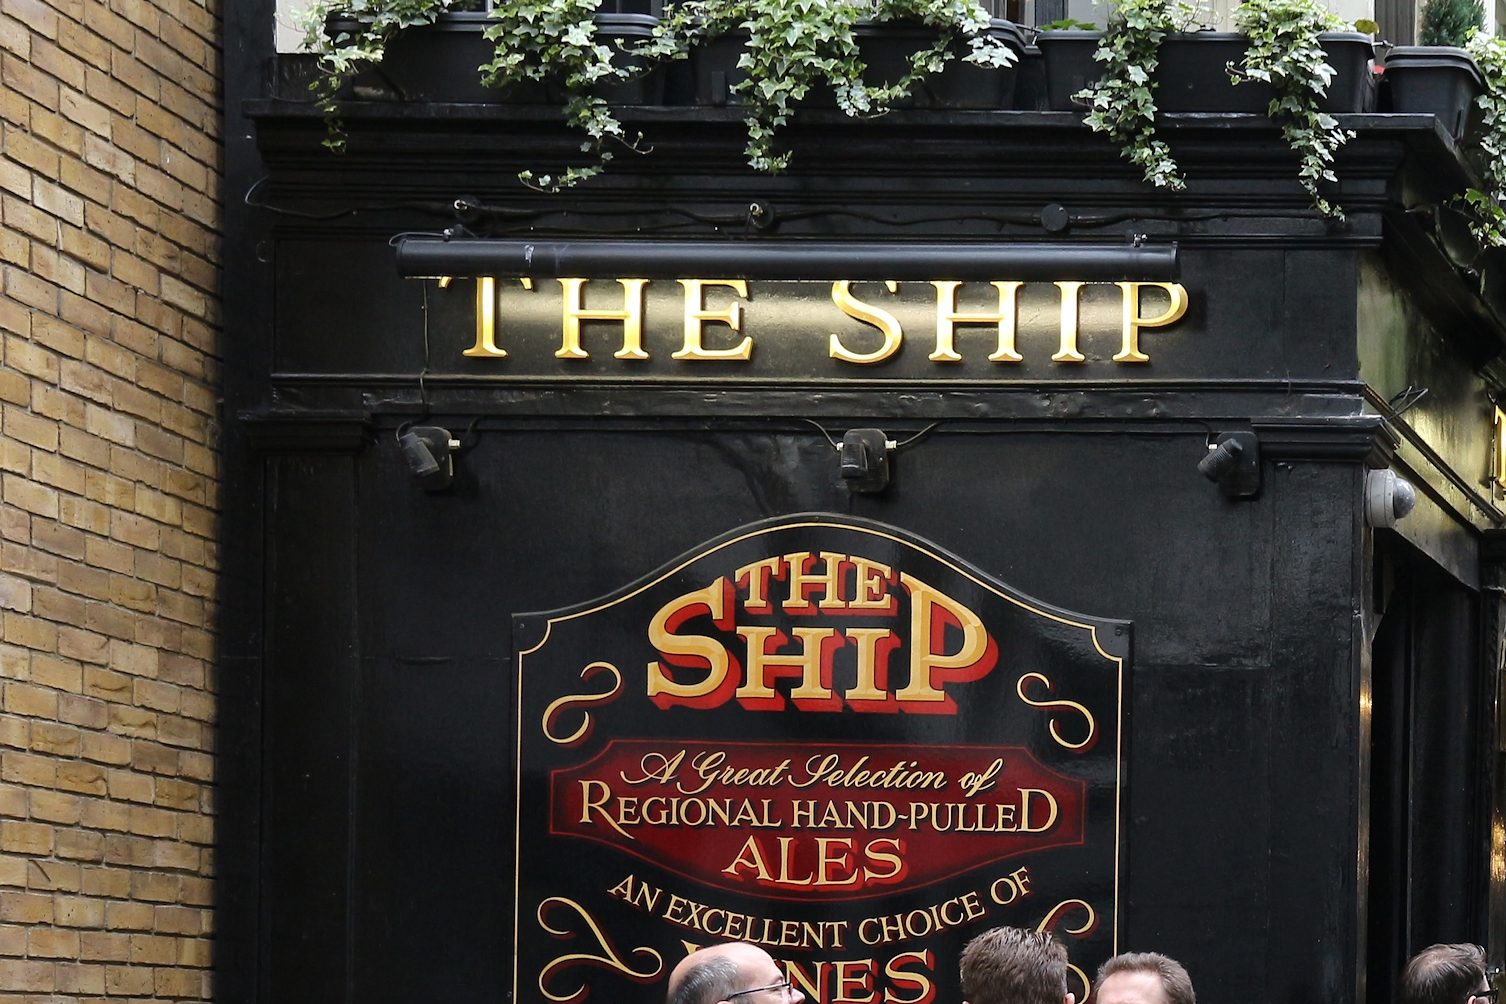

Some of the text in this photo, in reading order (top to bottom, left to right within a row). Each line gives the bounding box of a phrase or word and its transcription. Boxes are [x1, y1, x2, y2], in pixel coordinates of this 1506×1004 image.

[439, 276, 1188, 364] THE SHIP
[735, 551, 896, 613] THE
[647, 570, 994, 710] SHIP
[620, 750, 1003, 799] A Great Selection of
[578, 779, 1059, 839] REGIONAL HAND-PULLED
[721, 836, 906, 888] ALES
[607, 865, 1033, 948] AN EXCELLENT CHOICE OF
